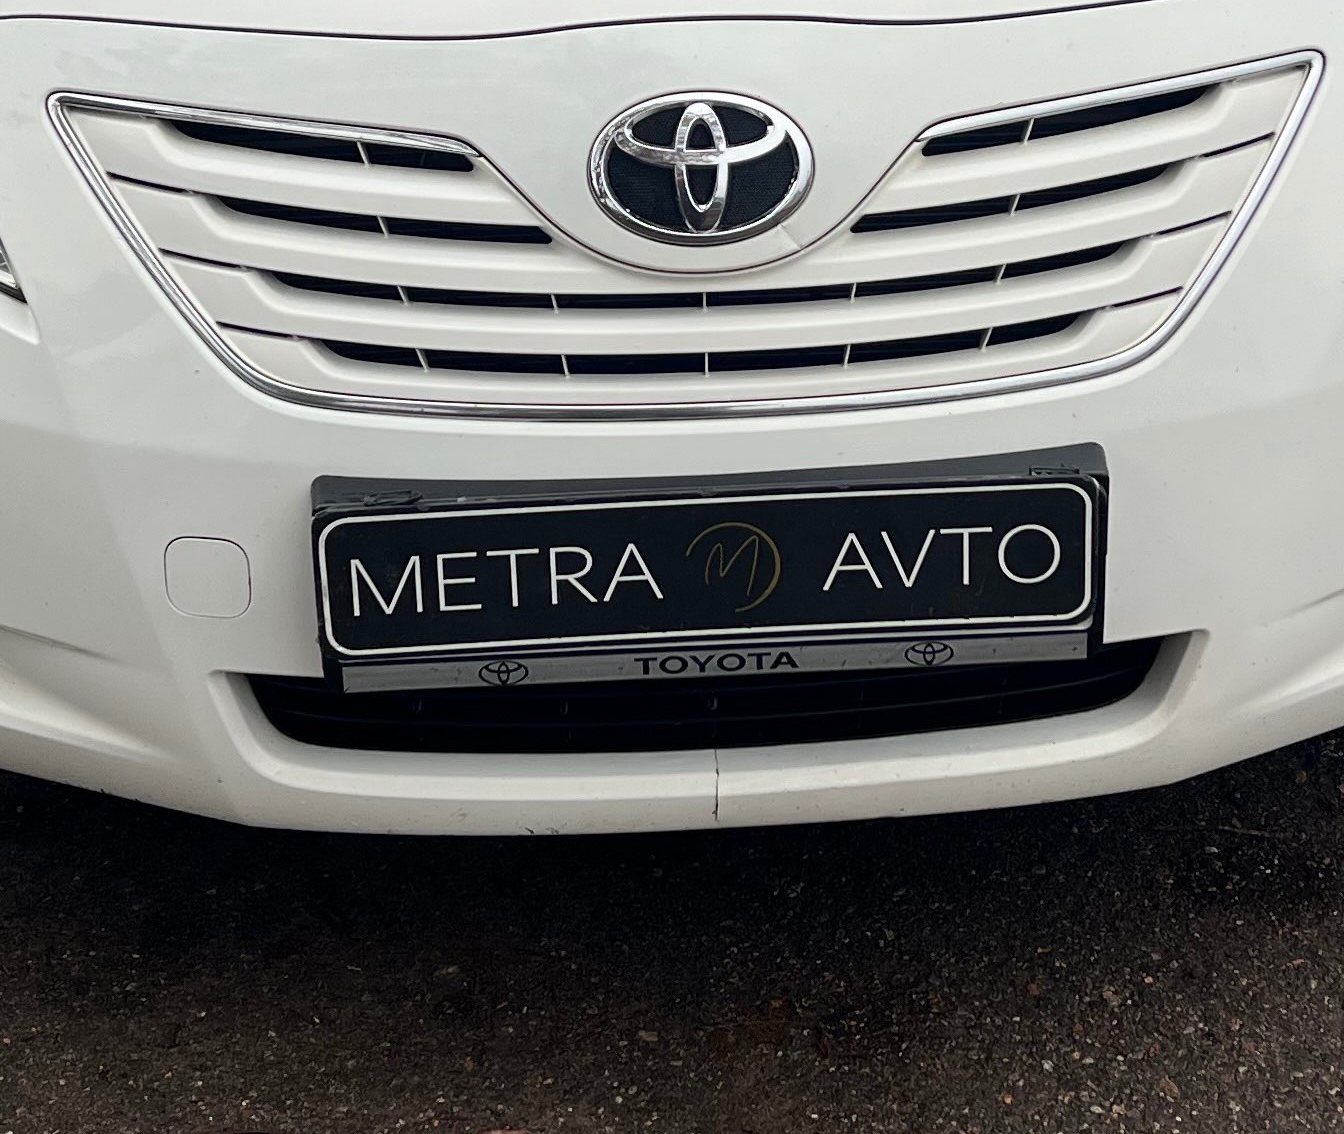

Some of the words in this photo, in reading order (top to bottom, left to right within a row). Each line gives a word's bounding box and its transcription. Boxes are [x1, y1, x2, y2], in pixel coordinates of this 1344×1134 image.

[350, 543, 664, 617] METRA
[822, 524, 1062, 592] AVTO
[634, 650, 800, 676] TOYOTA
